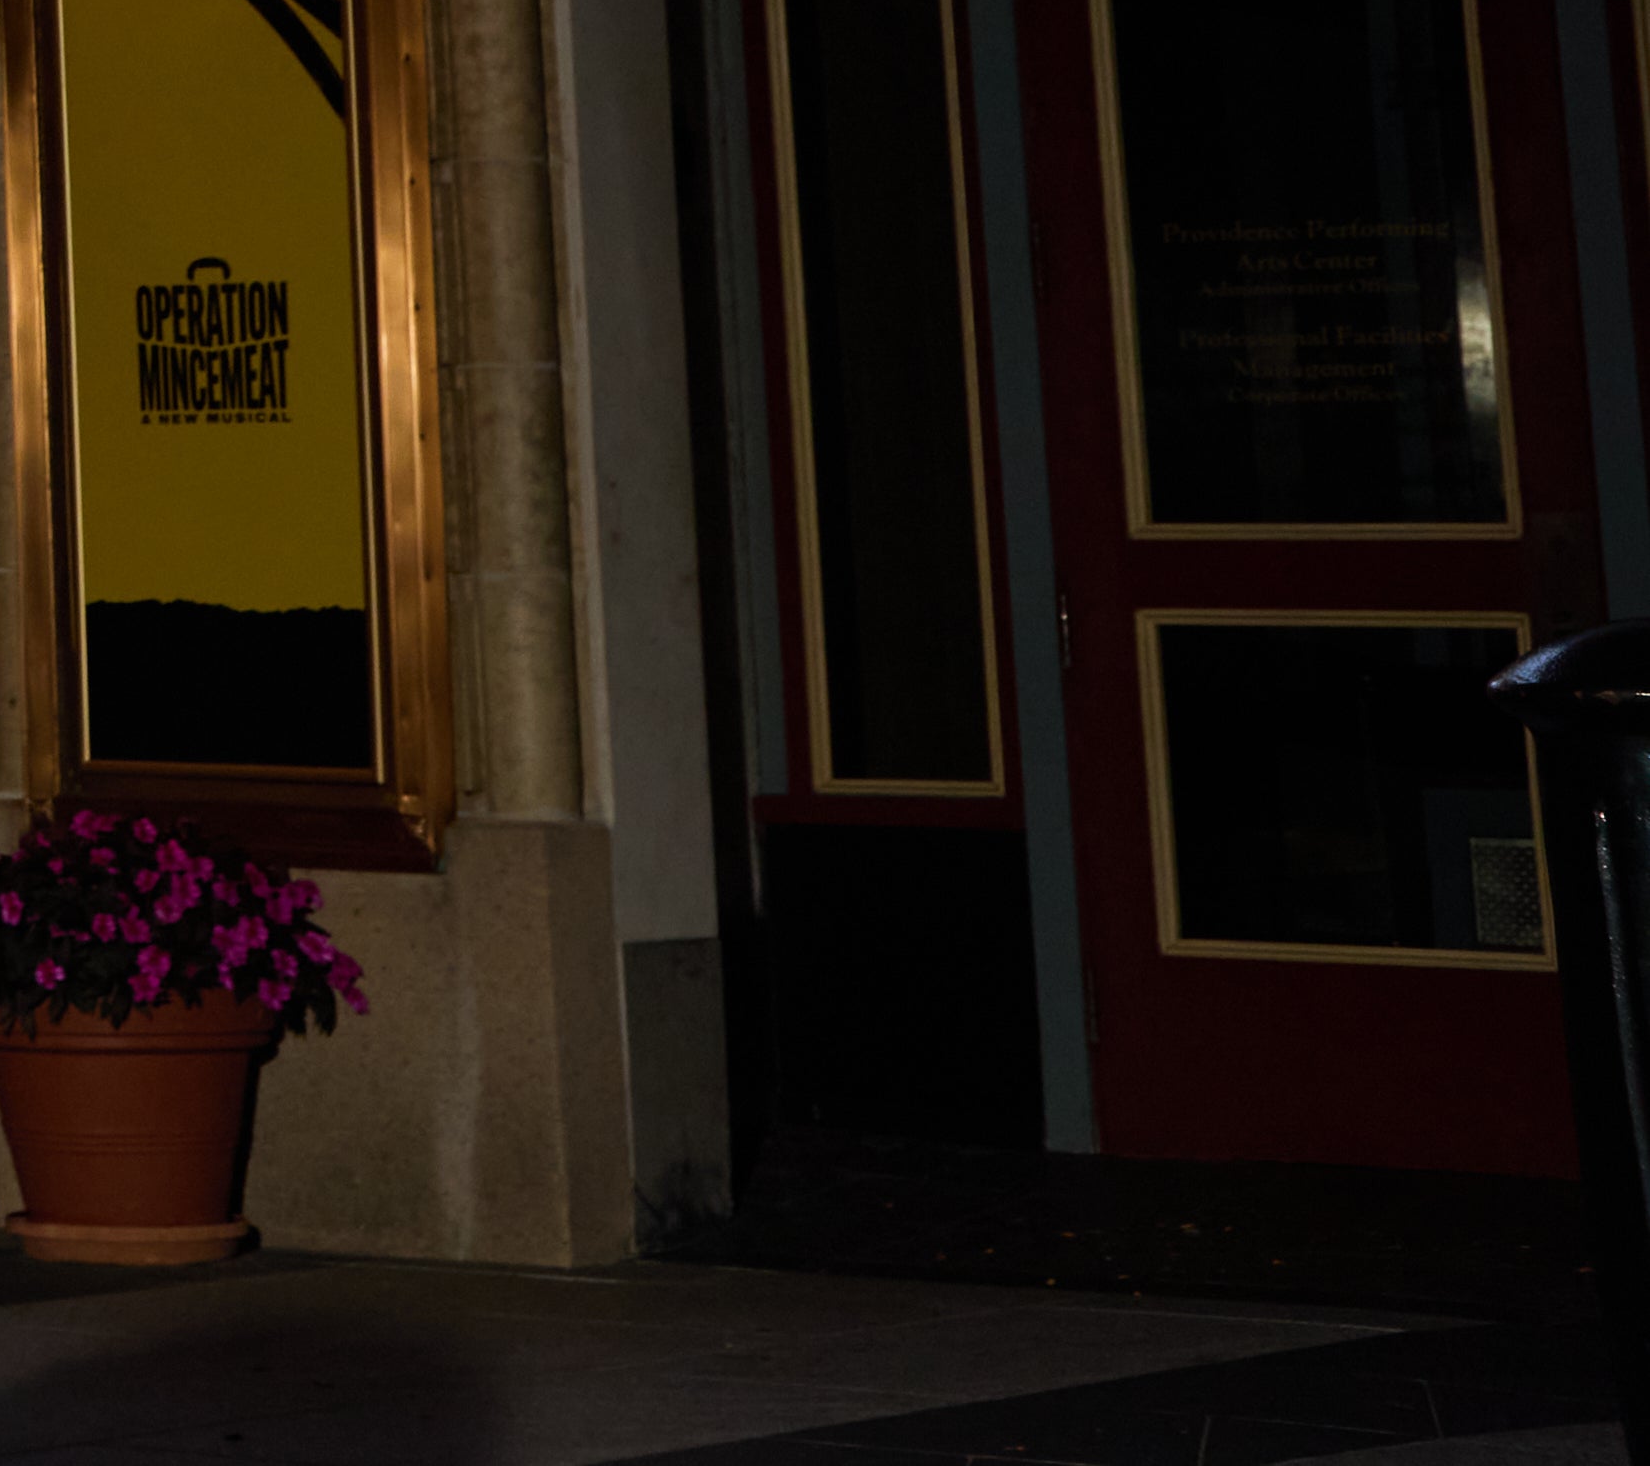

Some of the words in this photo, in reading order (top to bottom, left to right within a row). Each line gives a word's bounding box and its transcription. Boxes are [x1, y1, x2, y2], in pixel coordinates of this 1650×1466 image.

[1161, 219, 1300, 245] Providence
[1305, 216, 1450, 244] Performing
[1236, 252, 1289, 272] Arts
[1293, 250, 1378, 271] Center
[136, 280, 288, 347] OPERATION
[138, 339, 289, 412] MINCEMEAT
[142, 414, 151, 424] A
[159, 413, 199, 425] NEW
[206, 412, 291, 424] MUSICAL
